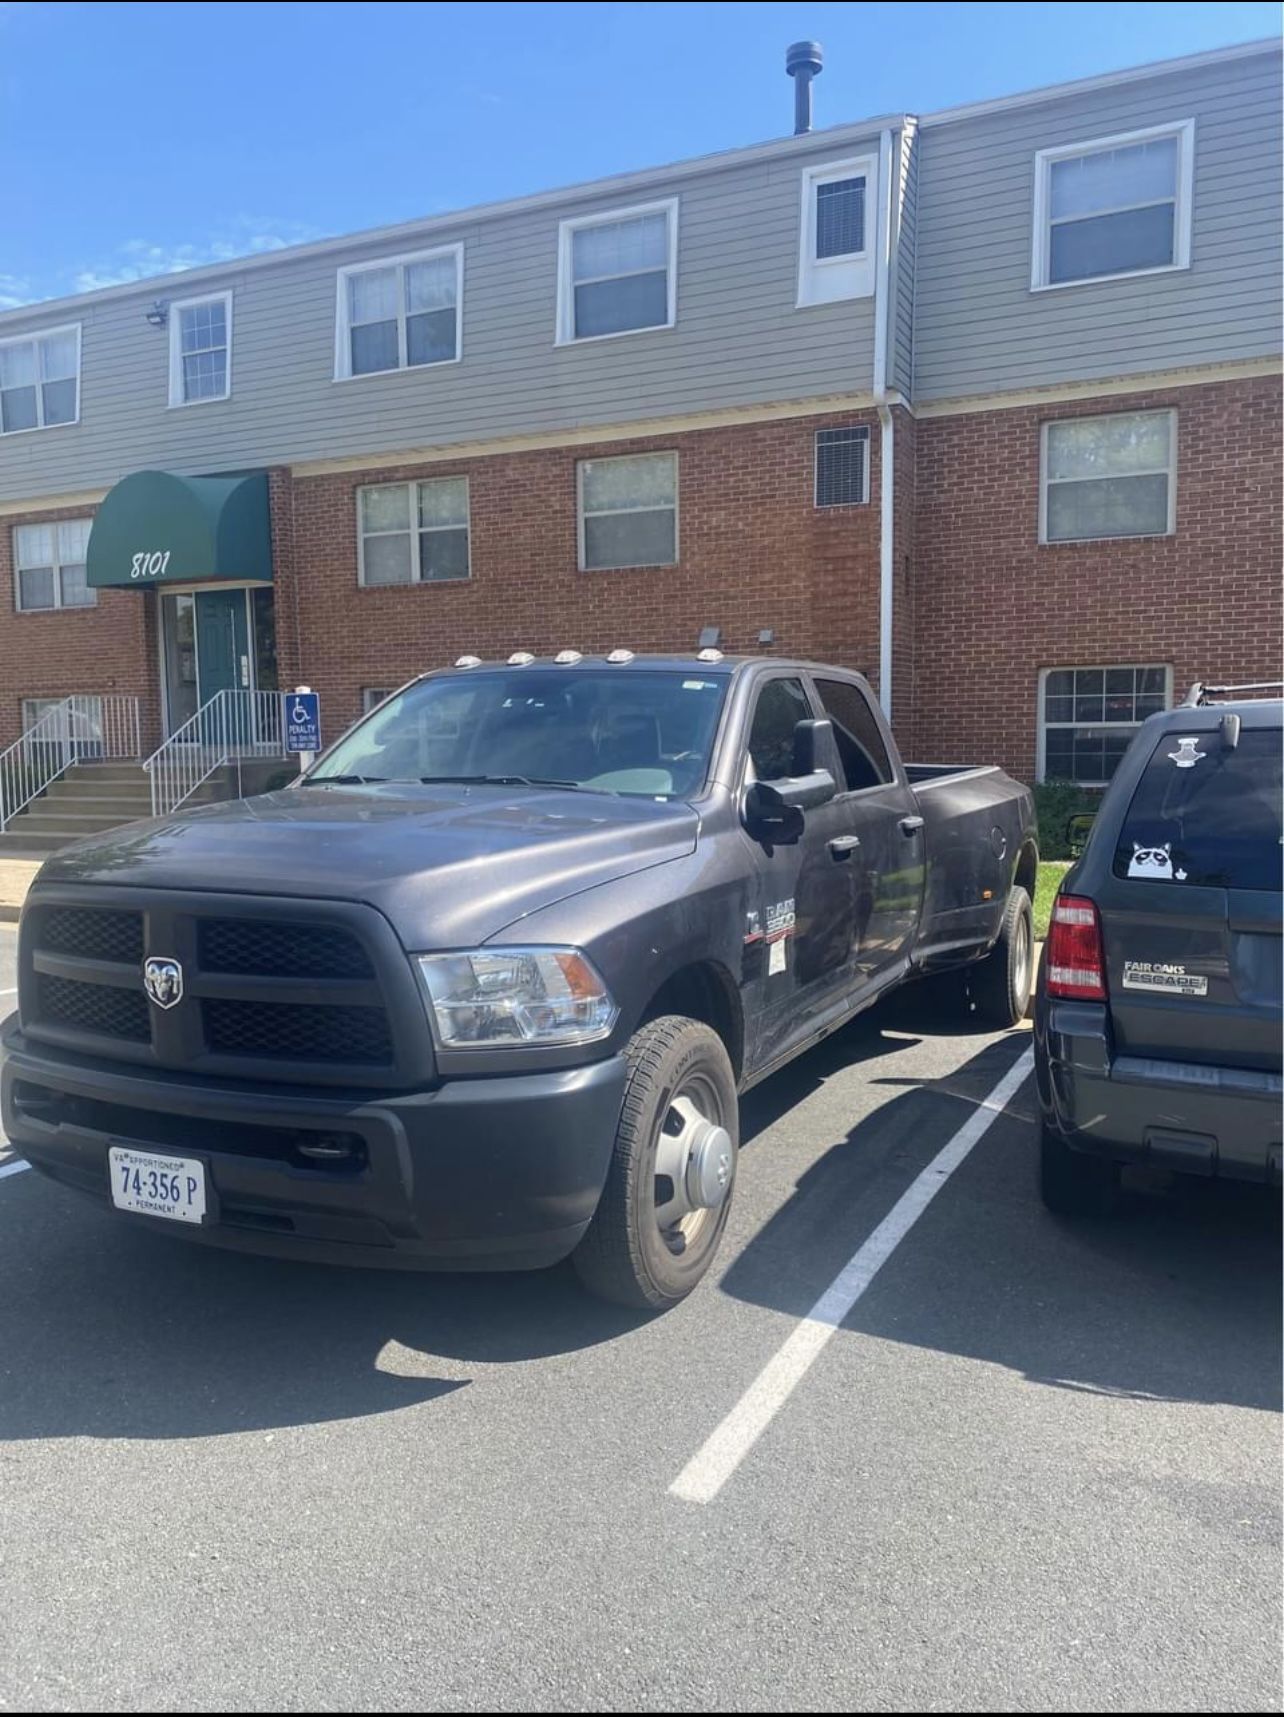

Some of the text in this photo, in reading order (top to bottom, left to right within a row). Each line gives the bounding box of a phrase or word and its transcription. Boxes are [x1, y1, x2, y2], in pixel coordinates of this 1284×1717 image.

[130, 550, 171, 578] 8101
[288, 724, 316, 735] PENALTY
[765, 897, 795, 919] RAM
[1124, 960, 1186, 975] FAIR OAKS
[1127, 972, 1201, 988] ESCAPE
[113, 1153, 180, 1172] VA APPORTIONED
[186, 1176, 198, 1206] P
[135, 1199, 176, 1214] PERMANENT
